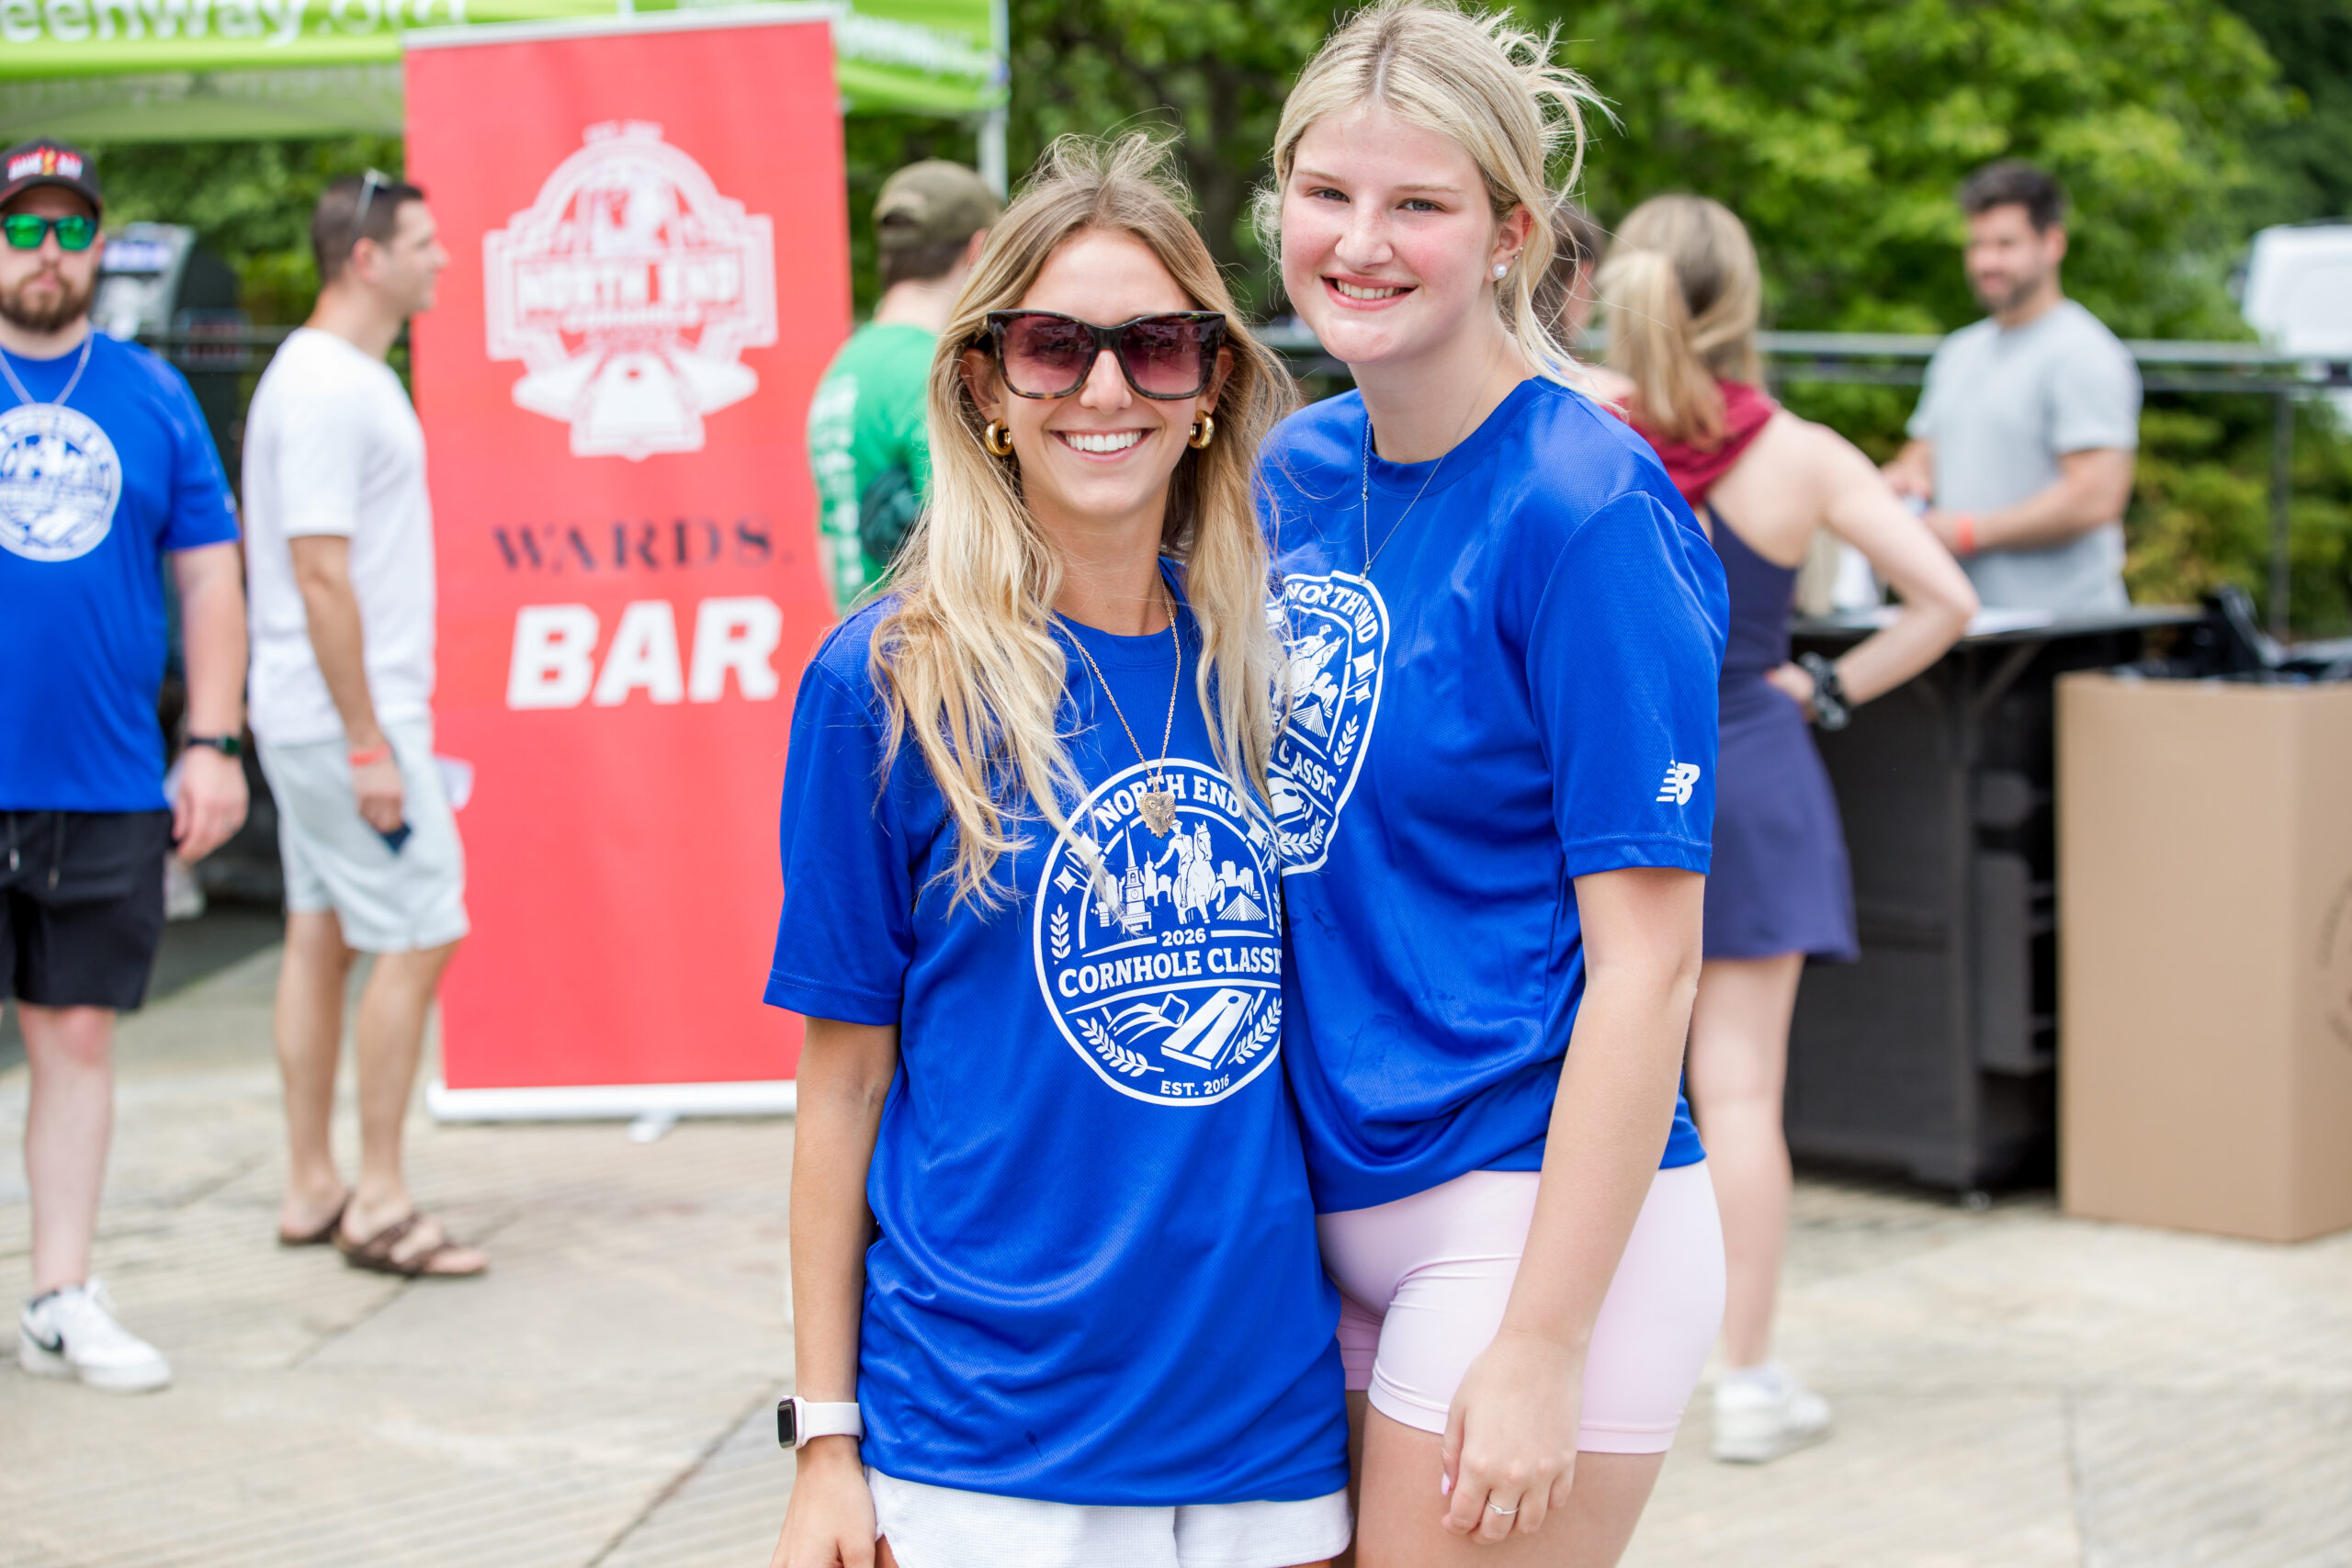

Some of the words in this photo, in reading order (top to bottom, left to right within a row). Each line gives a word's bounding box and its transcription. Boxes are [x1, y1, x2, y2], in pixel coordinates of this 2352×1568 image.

[505, 595, 784, 710] BAR
[1093, 773, 1187, 831] NORTH
[1193, 774, 1242, 818] END
[1161, 928, 1207, 947] 2026
[1058, 950, 1203, 998] CORNHOLE
[1207, 946, 1283, 976] CLASSI
[1160, 1079, 1199, 1096] EST.
[1203, 1073, 1229, 1095] 2016
